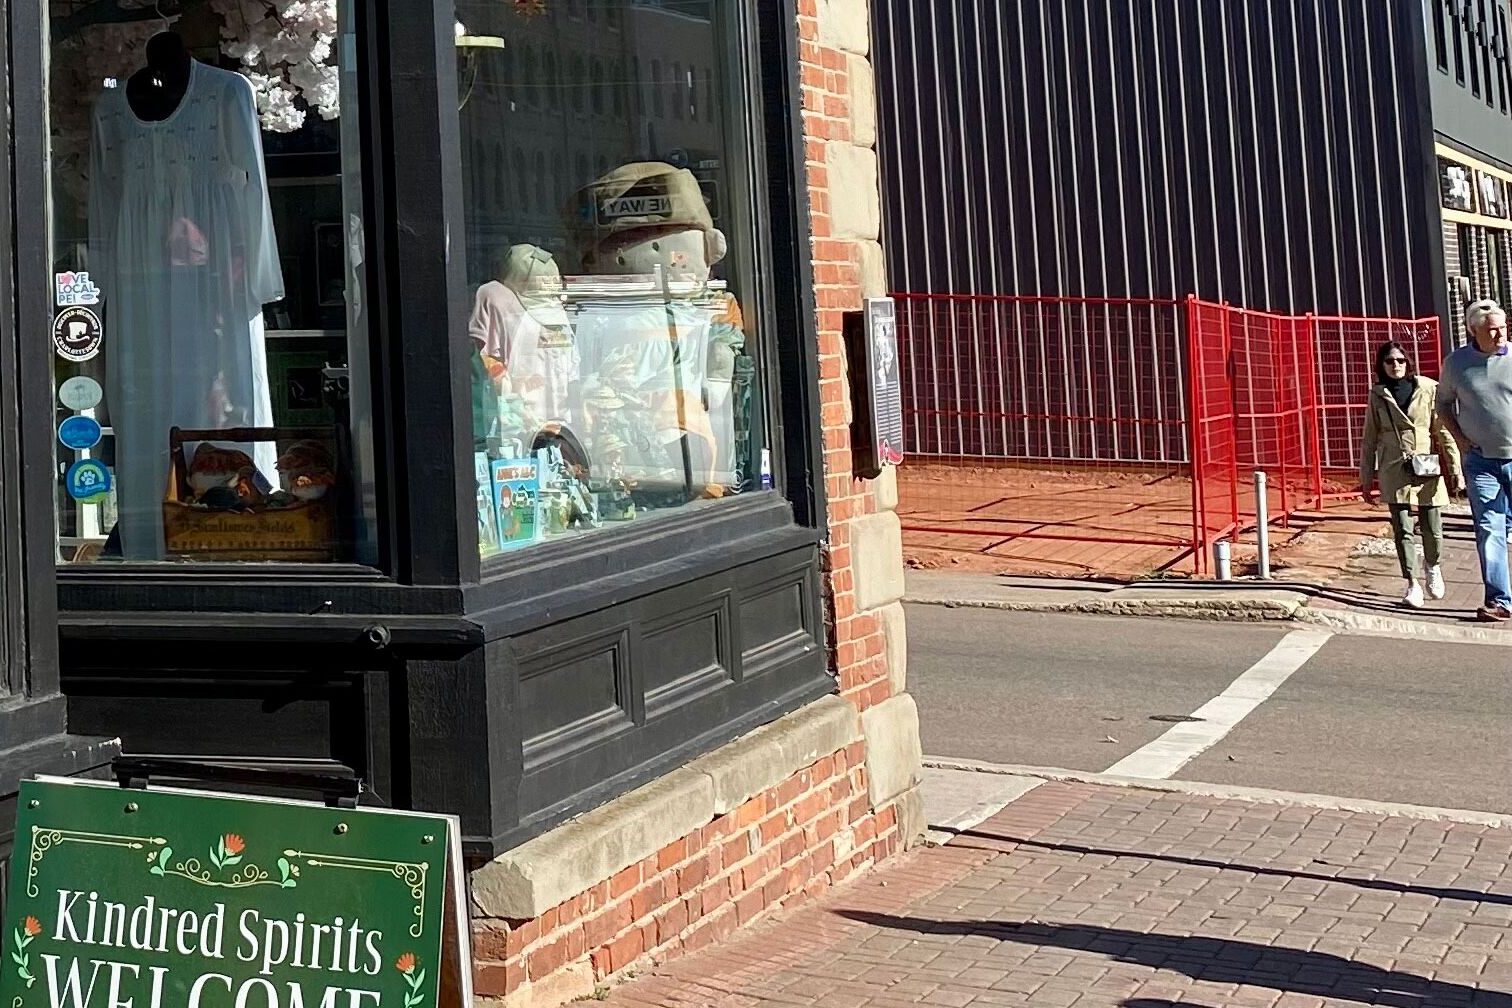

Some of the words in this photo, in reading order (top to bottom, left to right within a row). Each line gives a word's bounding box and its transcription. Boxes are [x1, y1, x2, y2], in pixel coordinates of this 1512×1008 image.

[57, 283, 96, 294] LOCAL
[58, 294, 77, 304] PEI
[51, 888, 226, 960] Kindred
[236, 907, 384, 977] Spirits
[39, 952, 383, 1008] WELC
